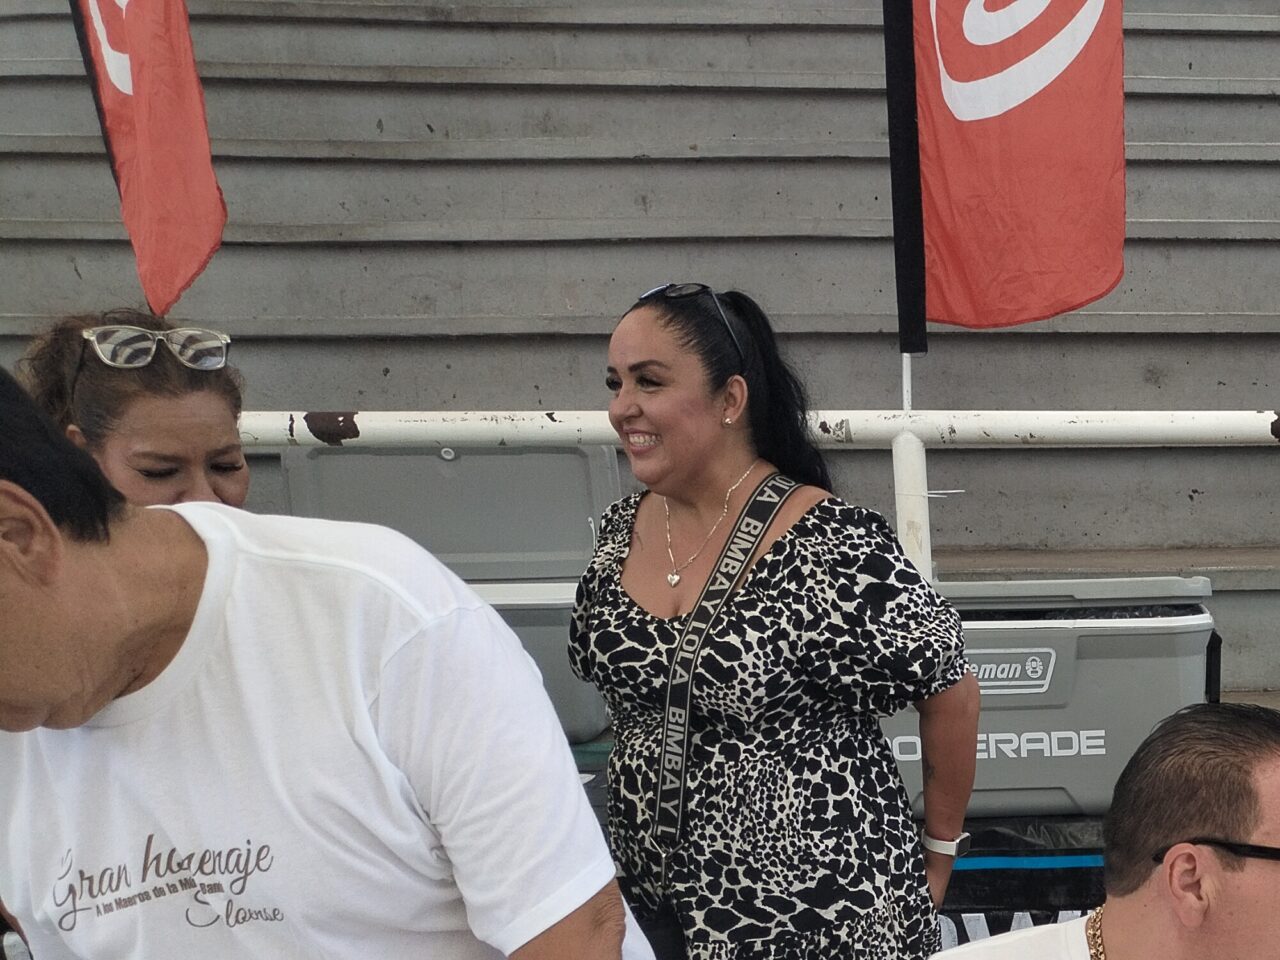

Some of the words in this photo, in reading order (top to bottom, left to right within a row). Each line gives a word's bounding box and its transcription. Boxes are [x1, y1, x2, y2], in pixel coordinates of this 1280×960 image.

[708, 516, 765, 592] BIMBA
[700, 598, 721, 615] Y
[673, 620, 711, 686] LOLA
[660, 705, 686, 791] BIMBA
[656, 793, 679, 814] Y
[152, 887, 166, 898] de
[166, 883, 179, 894] la
